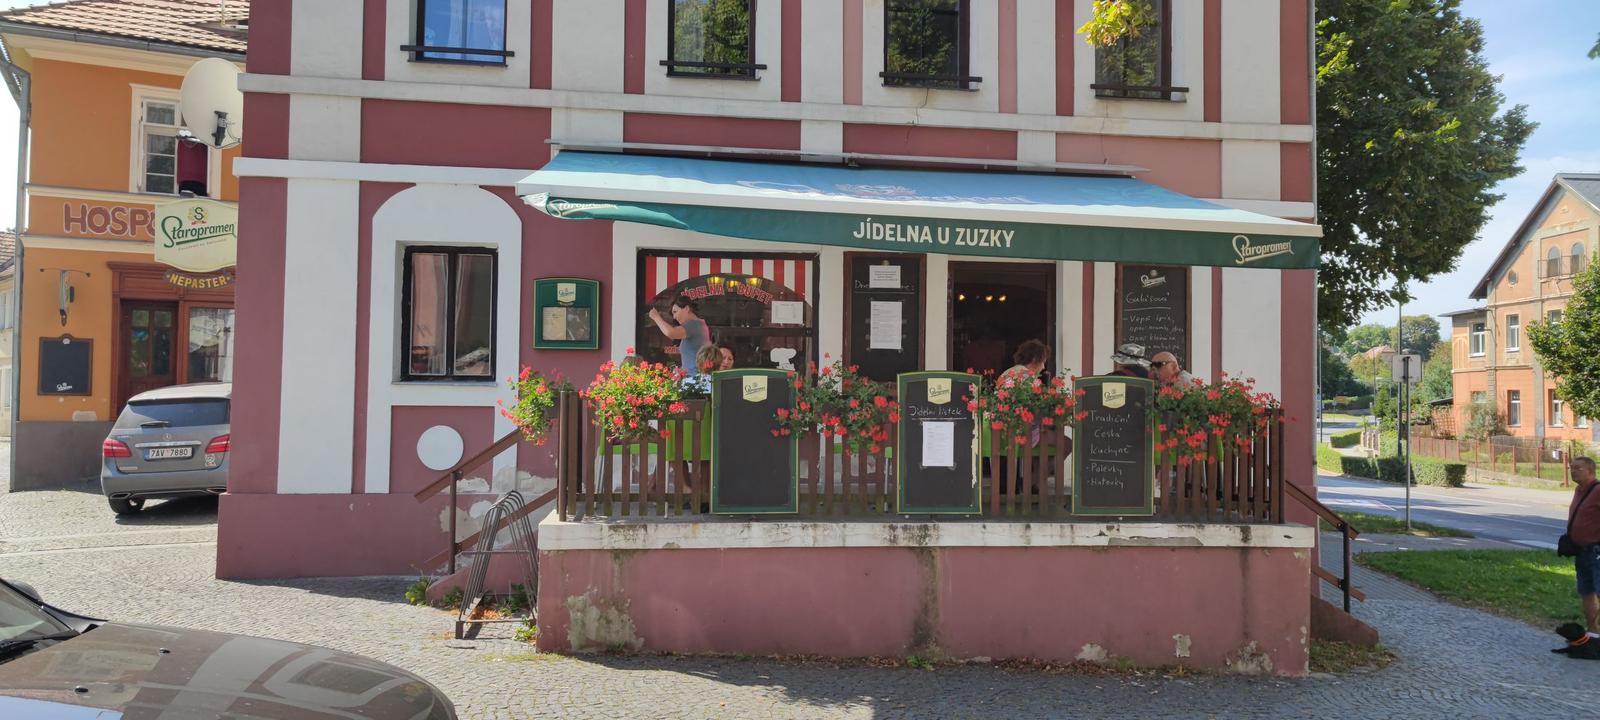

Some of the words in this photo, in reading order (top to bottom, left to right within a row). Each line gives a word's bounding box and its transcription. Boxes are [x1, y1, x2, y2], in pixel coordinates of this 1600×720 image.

[161, 216, 235, 248] Staropramen
[853, 218, 933, 244] JÍDELNA
[938, 227, 950, 244] U
[955, 228, 1014, 248] ZUZKY
[1232, 235, 1295, 264] Staropramen
[170, 274, 227, 289] NEPASTER
[151, 449, 165, 457] 7AV
